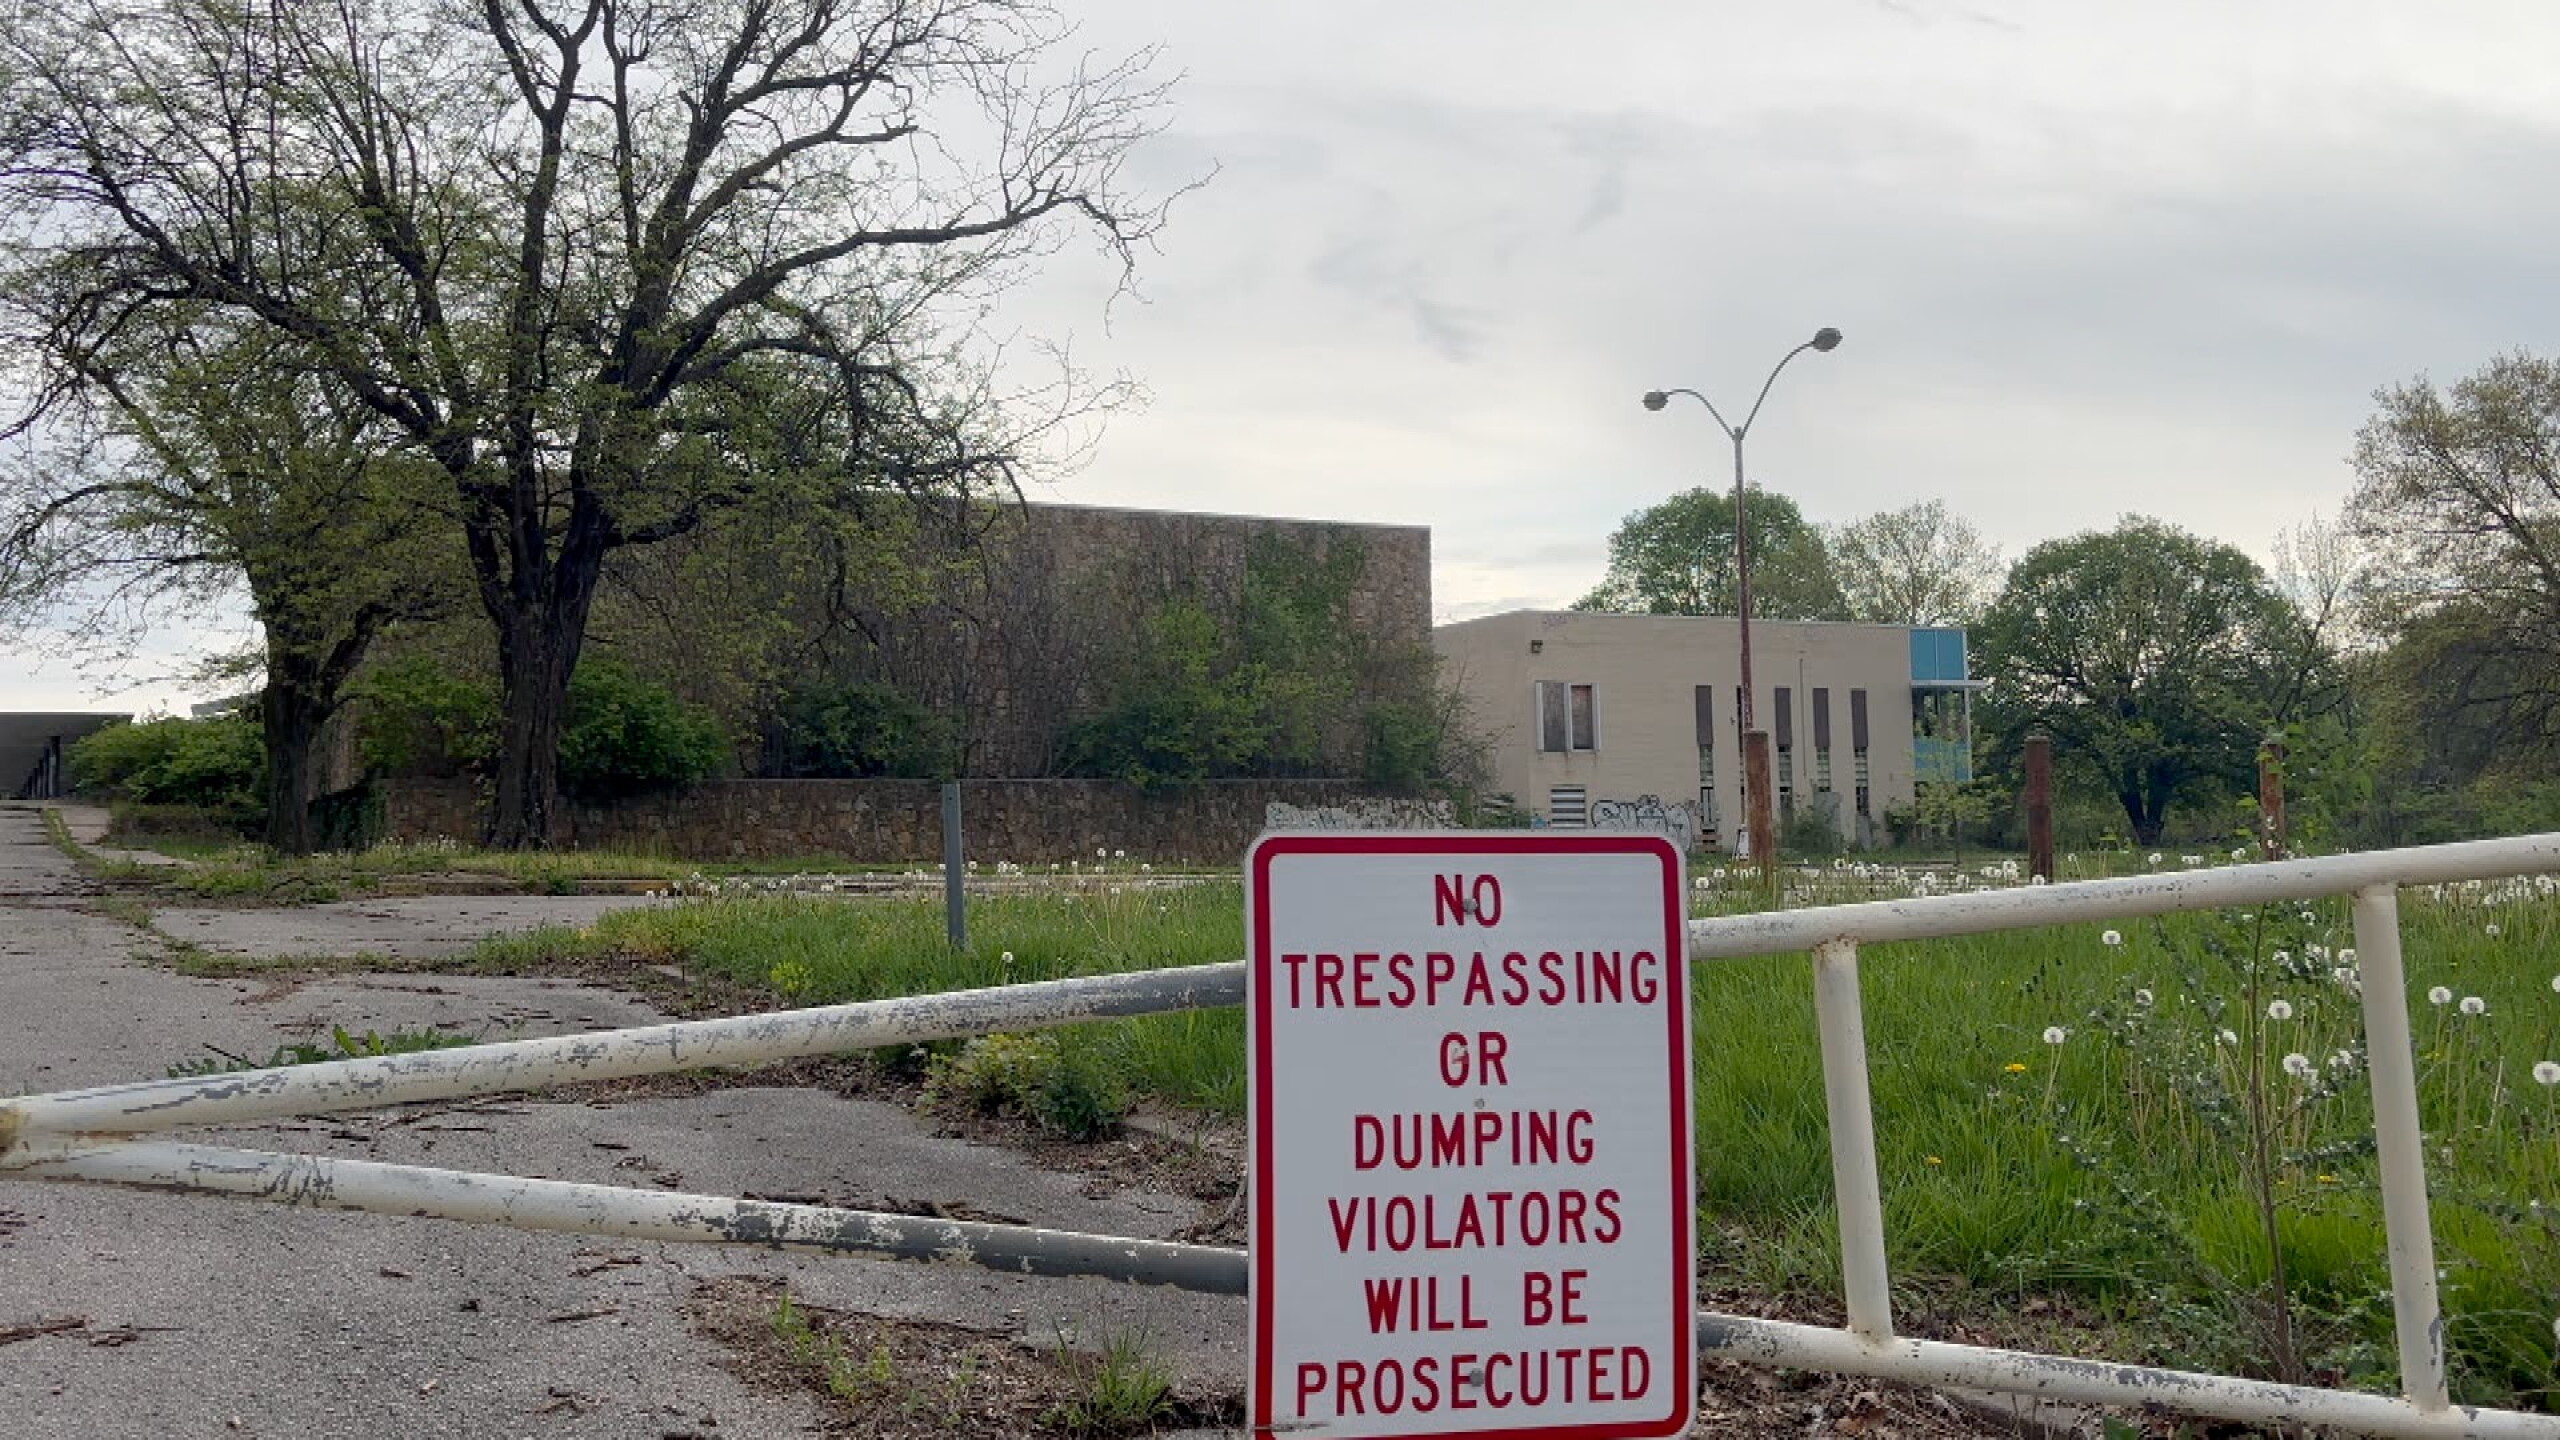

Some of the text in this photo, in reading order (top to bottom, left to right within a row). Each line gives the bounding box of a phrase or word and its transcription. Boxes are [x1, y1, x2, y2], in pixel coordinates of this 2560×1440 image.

[1434, 874, 1502, 926] NO
[1281, 951, 1659, 1008] TRESPASSING
[1439, 1031, 1509, 1087] OR
[1354, 1110, 1596, 1170] DUMPING
[1328, 1189, 1623, 1253] VIOLATORS
[1364, 1270, 1590, 1334] WILL BE
[1295, 1346, 1652, 1418] PROSECUTED
